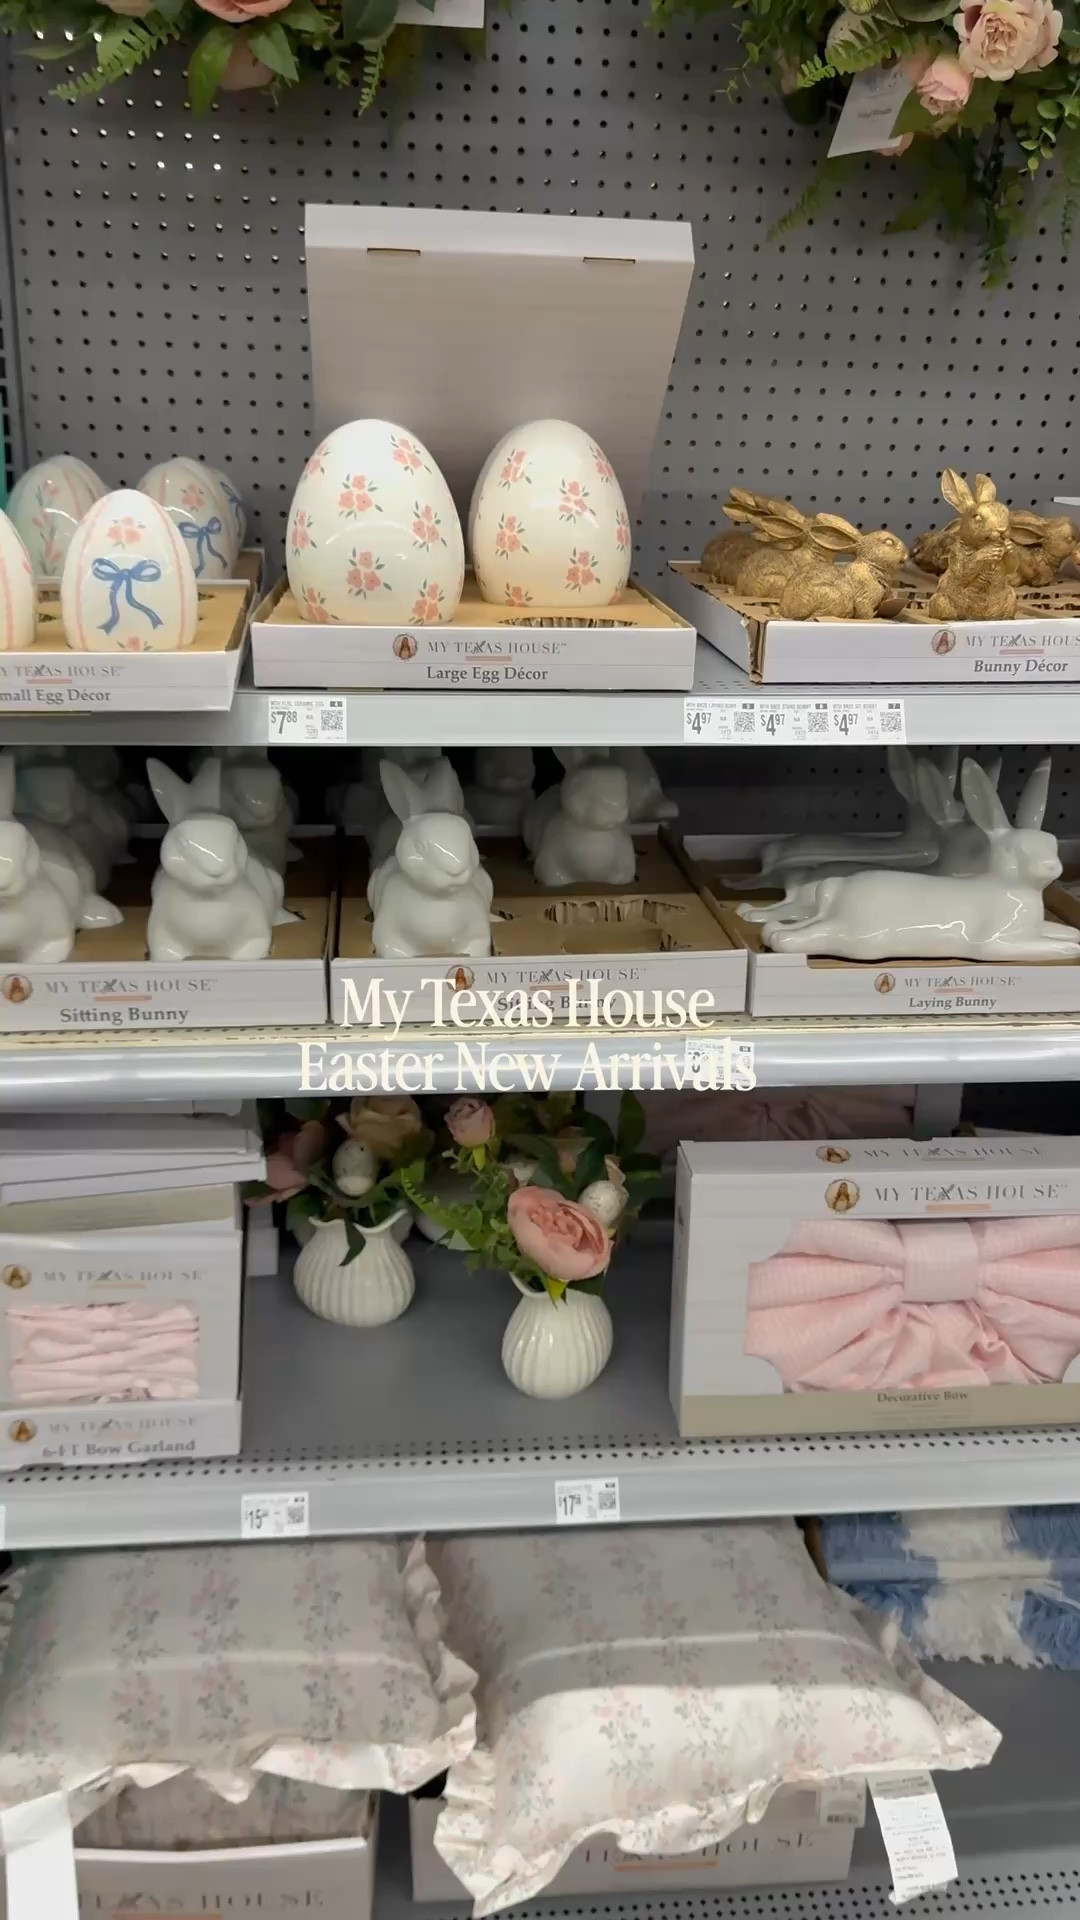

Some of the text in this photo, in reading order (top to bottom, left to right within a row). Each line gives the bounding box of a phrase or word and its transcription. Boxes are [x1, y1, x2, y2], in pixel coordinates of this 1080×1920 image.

[428, 641, 447, 653] MY
[454, 640, 503, 654] TEXAS
[966, 633, 1080, 648] MY TEXAS HOUS
[0, 666, 7, 677] Y
[14, 664, 62, 677] TEXAS
[974, 658, 1068, 676] Bunny Décor
[427, 666, 548, 684] Large Egg Décor
[0, 688, 111, 705] mall Egg Décor
[487, 972, 509, 984] MY
[516, 969, 573, 984] TEXAS
[904, 978, 920, 987] MY
[927, 976, 966, 987] TEXAS
[46, 981, 69, 993] MY
[78, 979, 139, 993] TEXAS
[909, 997, 997, 1010] Laying Bunny
[60, 1007, 188, 1025] Sitting Bunny
[875, 1188, 899, 1201] MY
[911, 1184, 977, 1201] TEXAS
[944, 1391, 968, 1400] Bow
[86, 1443, 121, 1454] Bow
[127, 1440, 195, 1453] Garland
